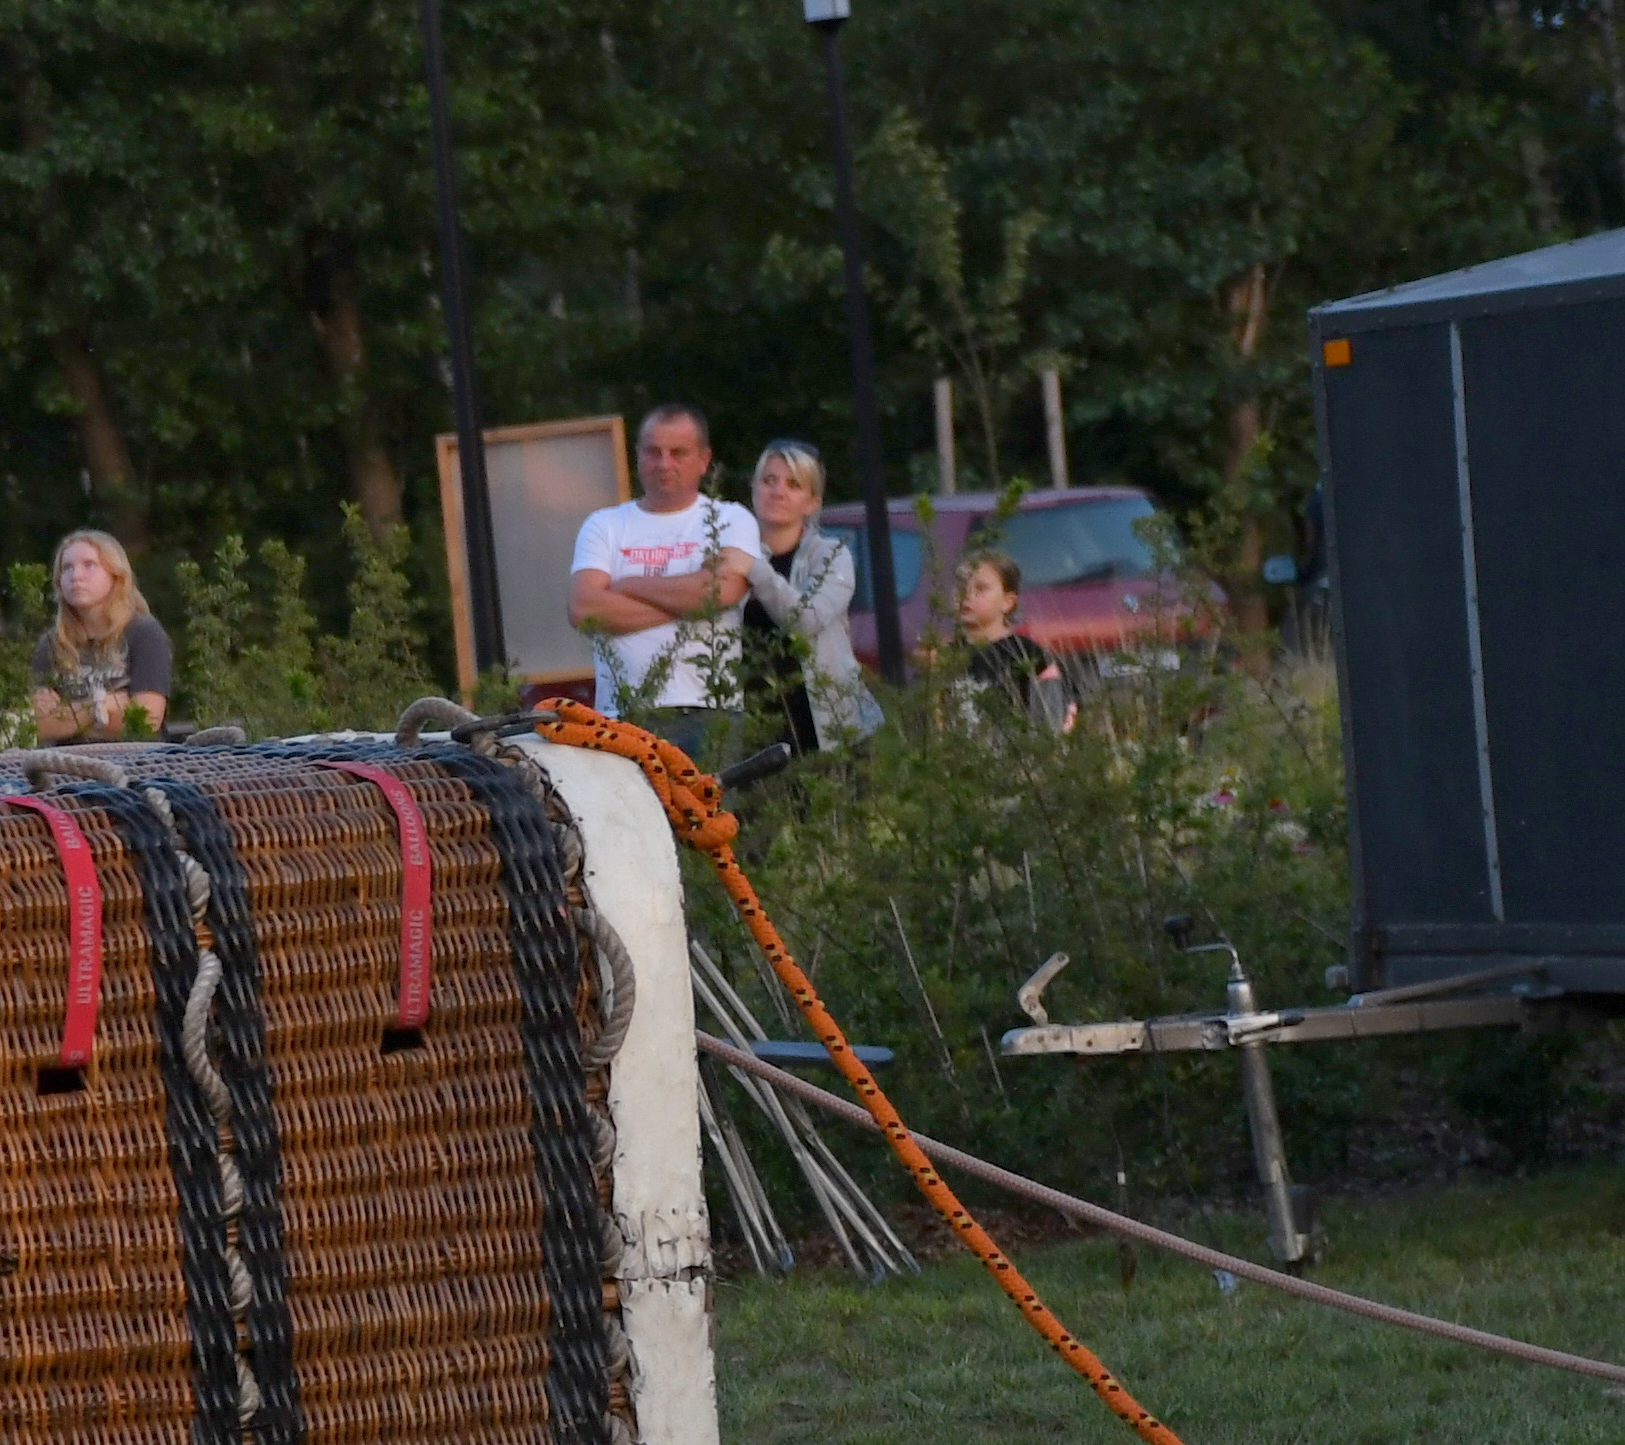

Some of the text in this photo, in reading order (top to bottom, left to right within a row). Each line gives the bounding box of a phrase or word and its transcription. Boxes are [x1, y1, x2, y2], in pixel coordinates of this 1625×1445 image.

[75, 885, 95, 1005] ULTRAMAGIC
[389, 788, 425, 1026] ULTRAMAGIC BALLOONS
